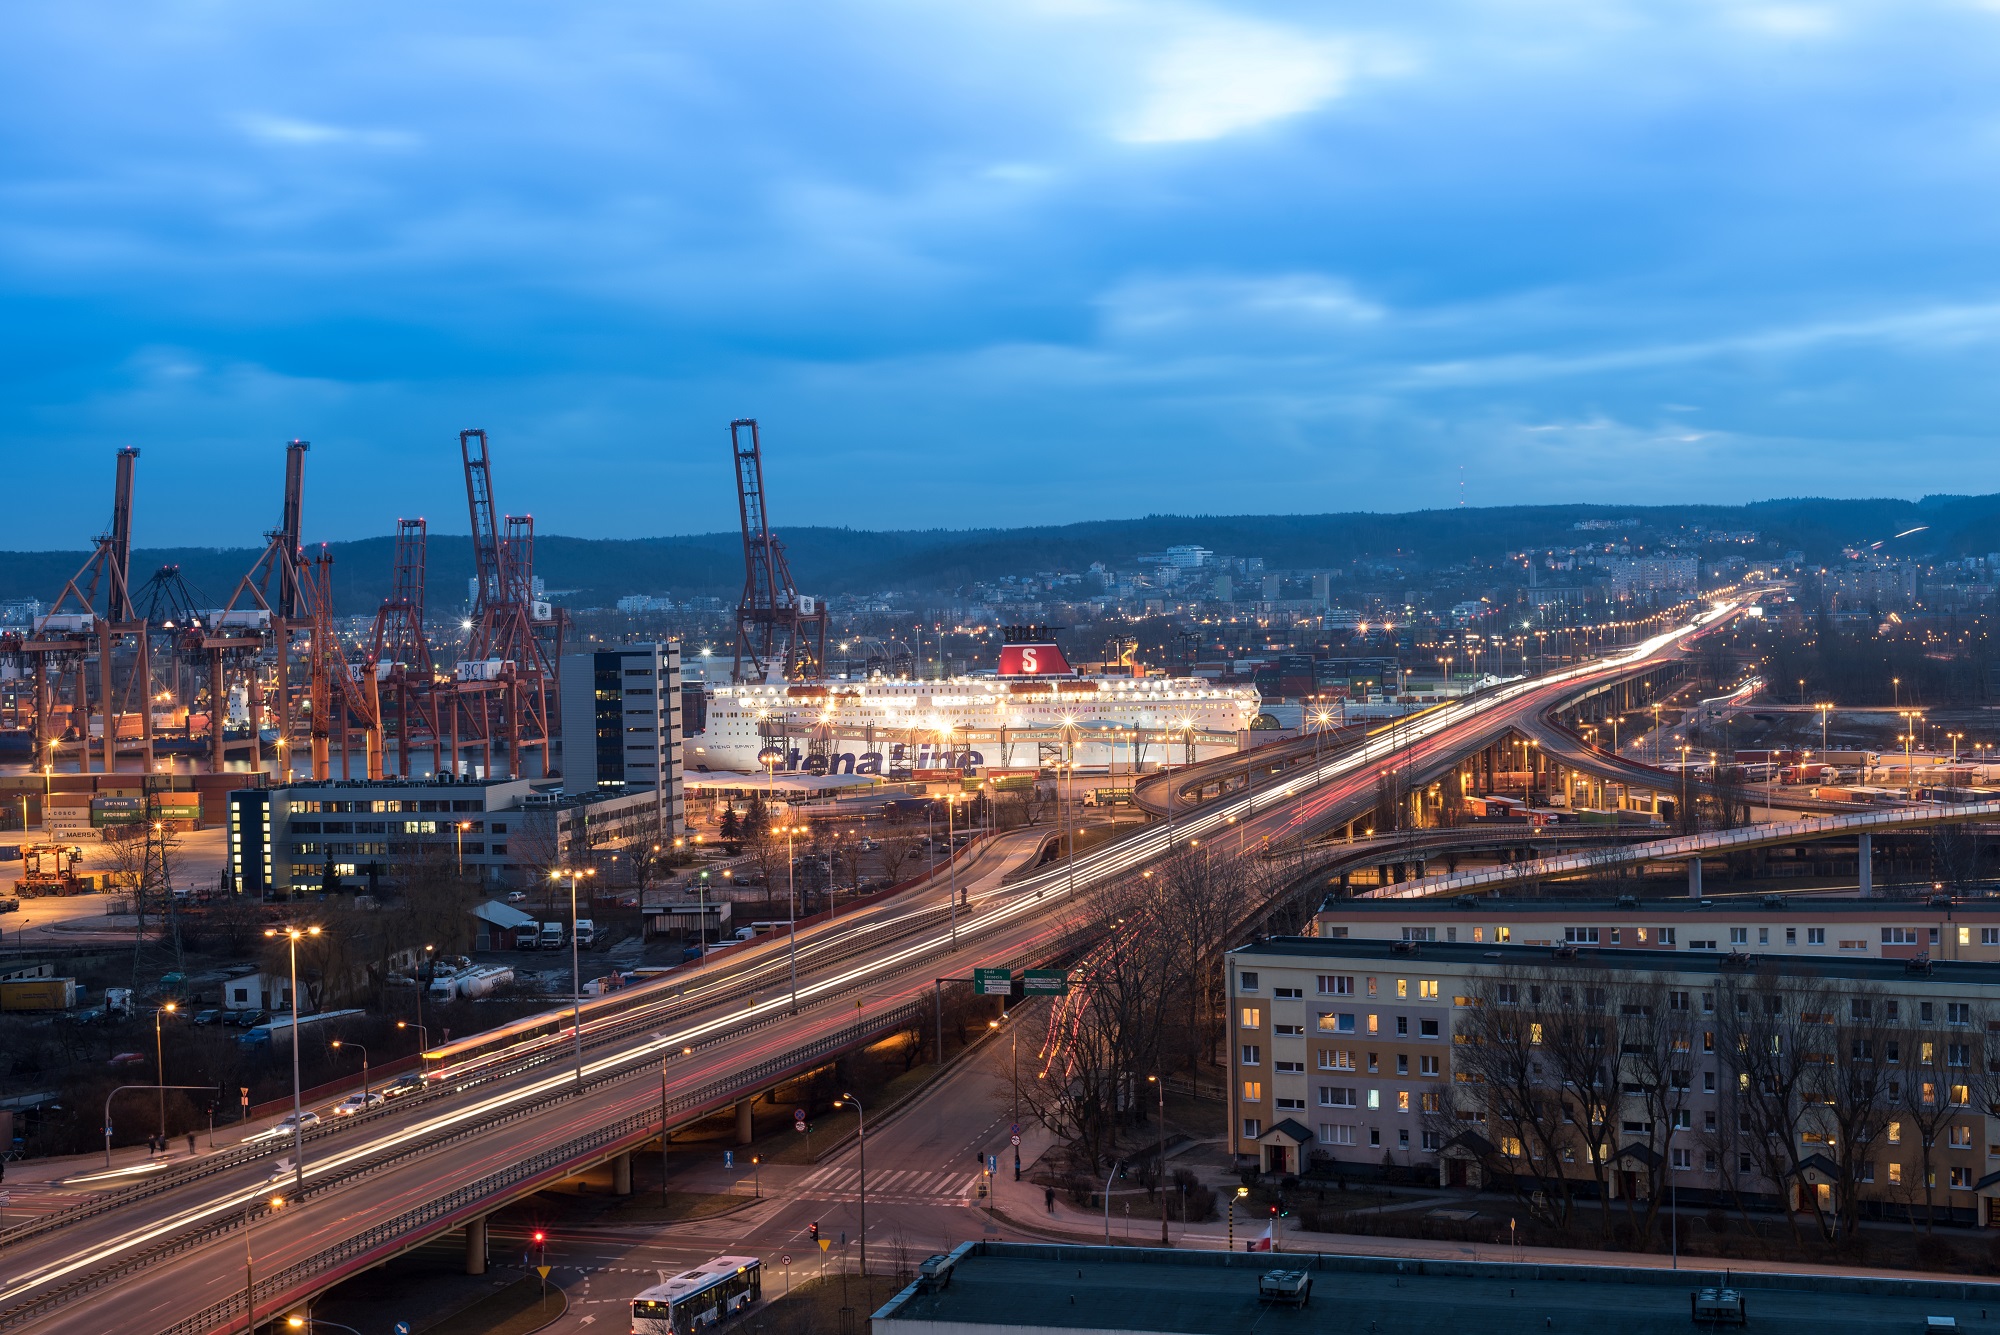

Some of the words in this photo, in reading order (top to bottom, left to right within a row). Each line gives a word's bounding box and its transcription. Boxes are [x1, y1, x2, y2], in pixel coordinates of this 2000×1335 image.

[1022, 648, 1037, 672] S
[464, 663, 485, 676] BCT
[1275, 1134, 1281, 1142] A
[1809, 1172, 1816, 1181] D
